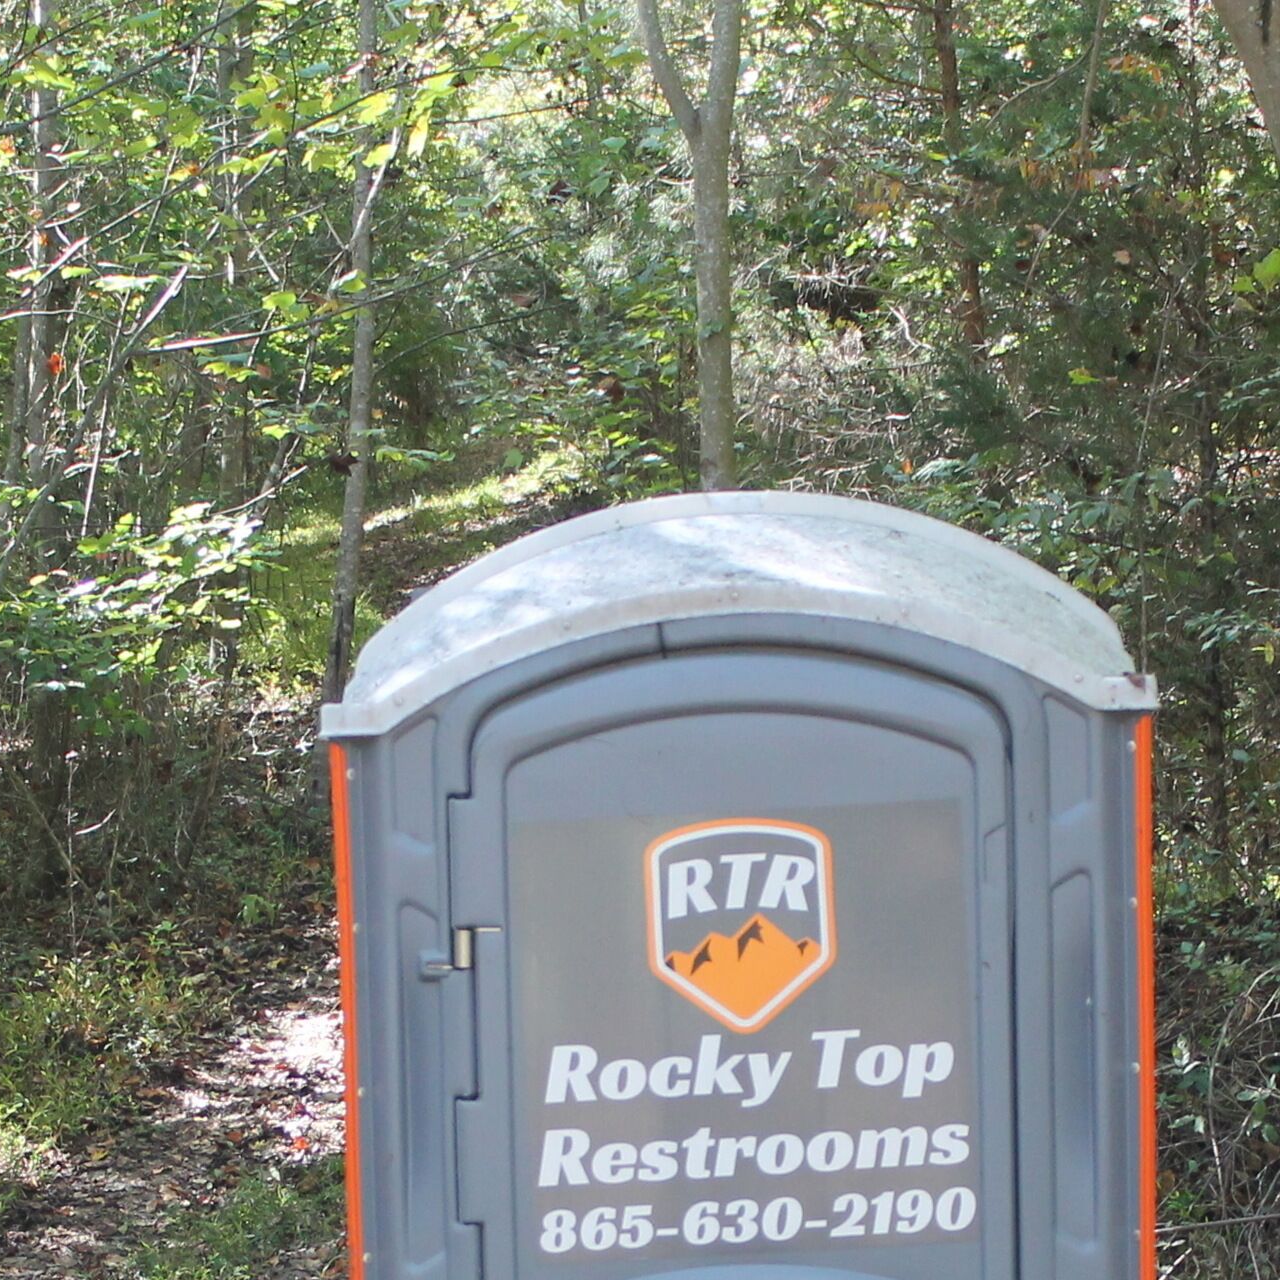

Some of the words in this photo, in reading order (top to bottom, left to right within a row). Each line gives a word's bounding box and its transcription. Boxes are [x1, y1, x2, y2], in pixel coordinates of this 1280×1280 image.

[667, 852, 815, 920] RTR
[544, 1034, 793, 1107] Rocky
[811, 1029, 955, 1098] Top
[537, 1123, 970, 1187] Restrooms
[538, 1186, 977, 1253] 865-630-2190
